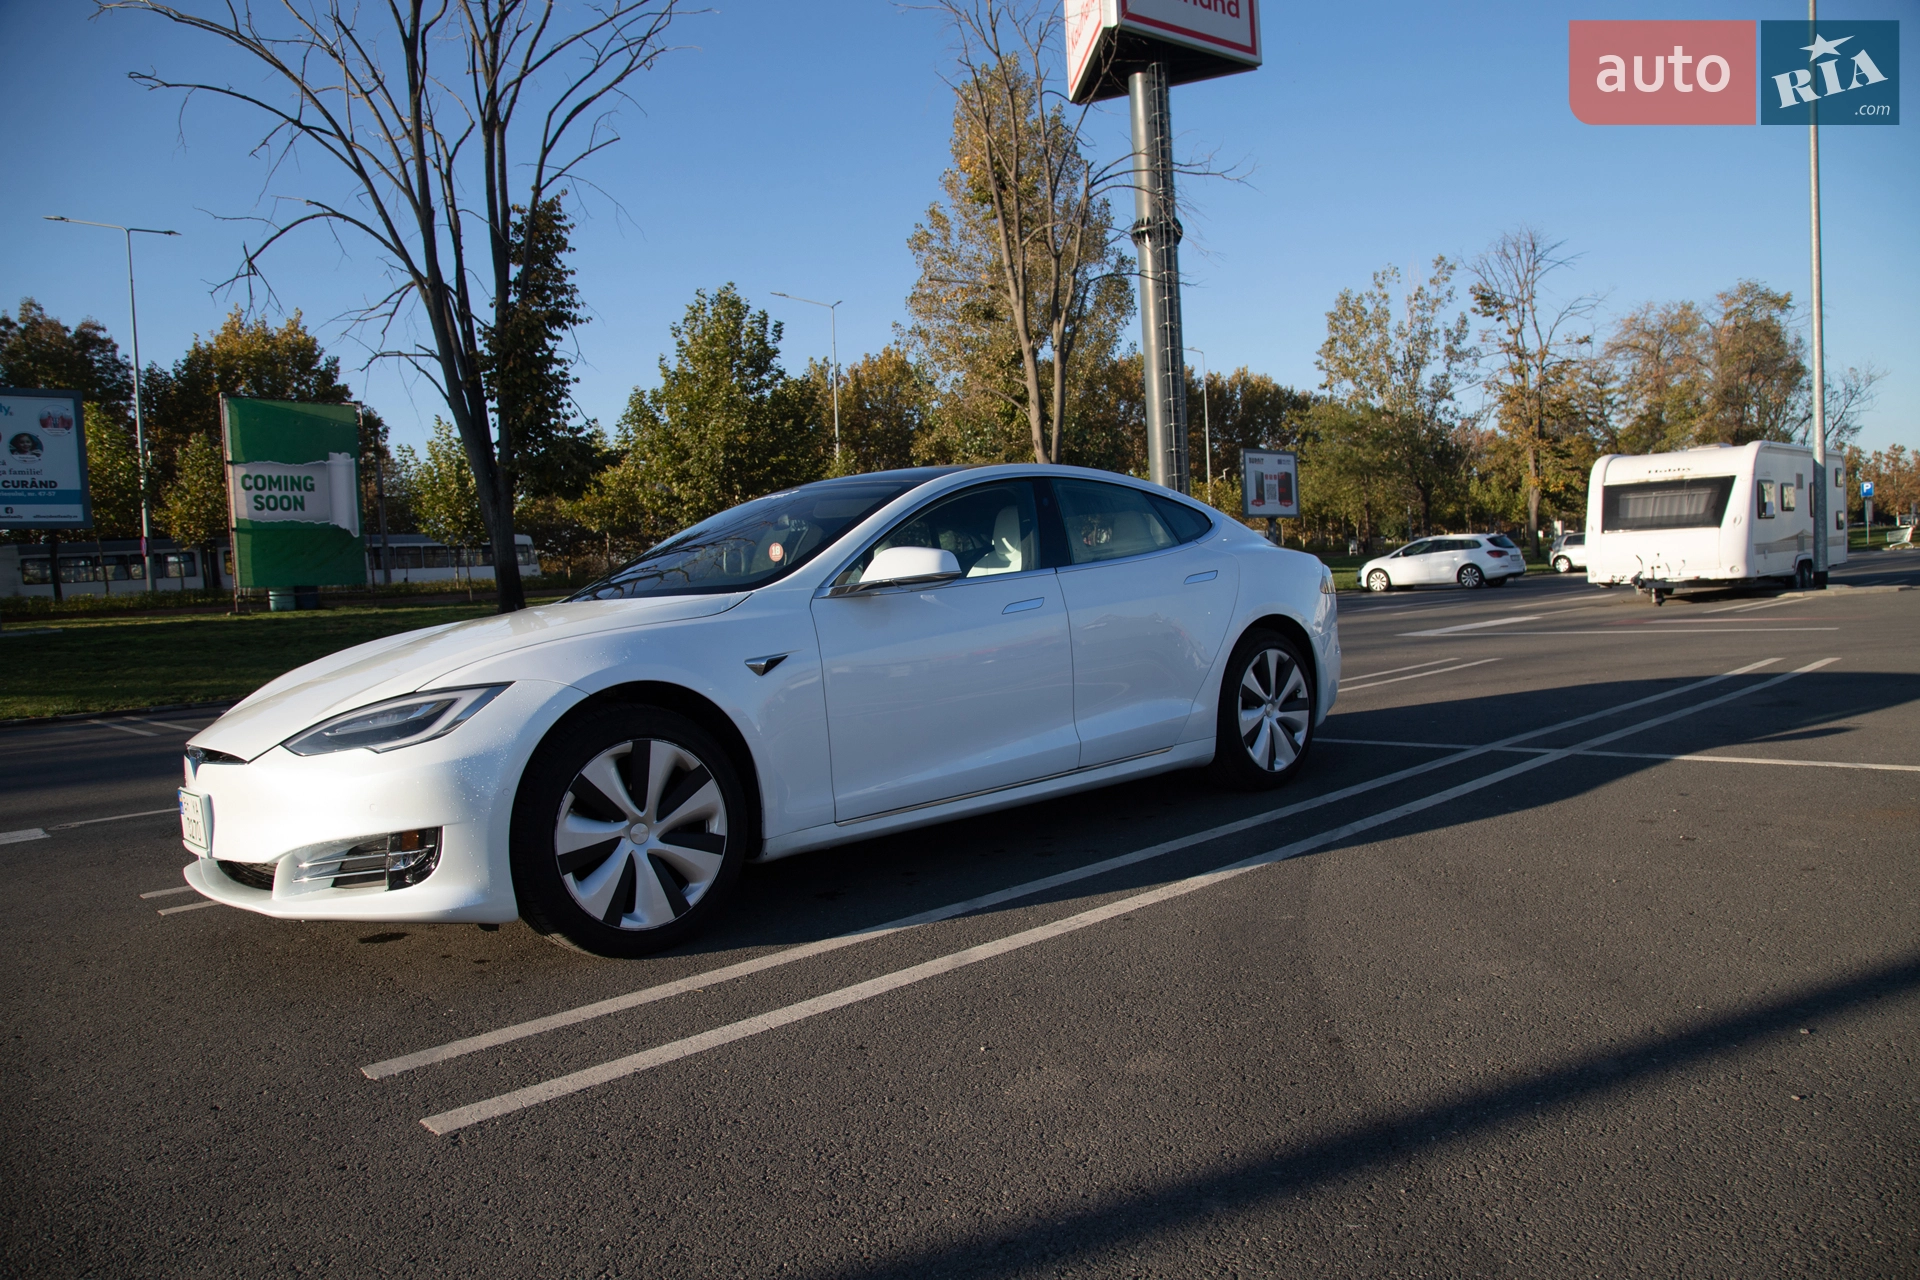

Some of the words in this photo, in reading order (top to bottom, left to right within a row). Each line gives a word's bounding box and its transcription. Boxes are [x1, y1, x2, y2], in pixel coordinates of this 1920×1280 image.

[1, 477, 58, 489] CURÂND
[240, 474, 315, 493] COMING
[1863, 483, 1871, 493] P
[253, 494, 305, 512] SOON
[772, 546, 781, 556] 18
